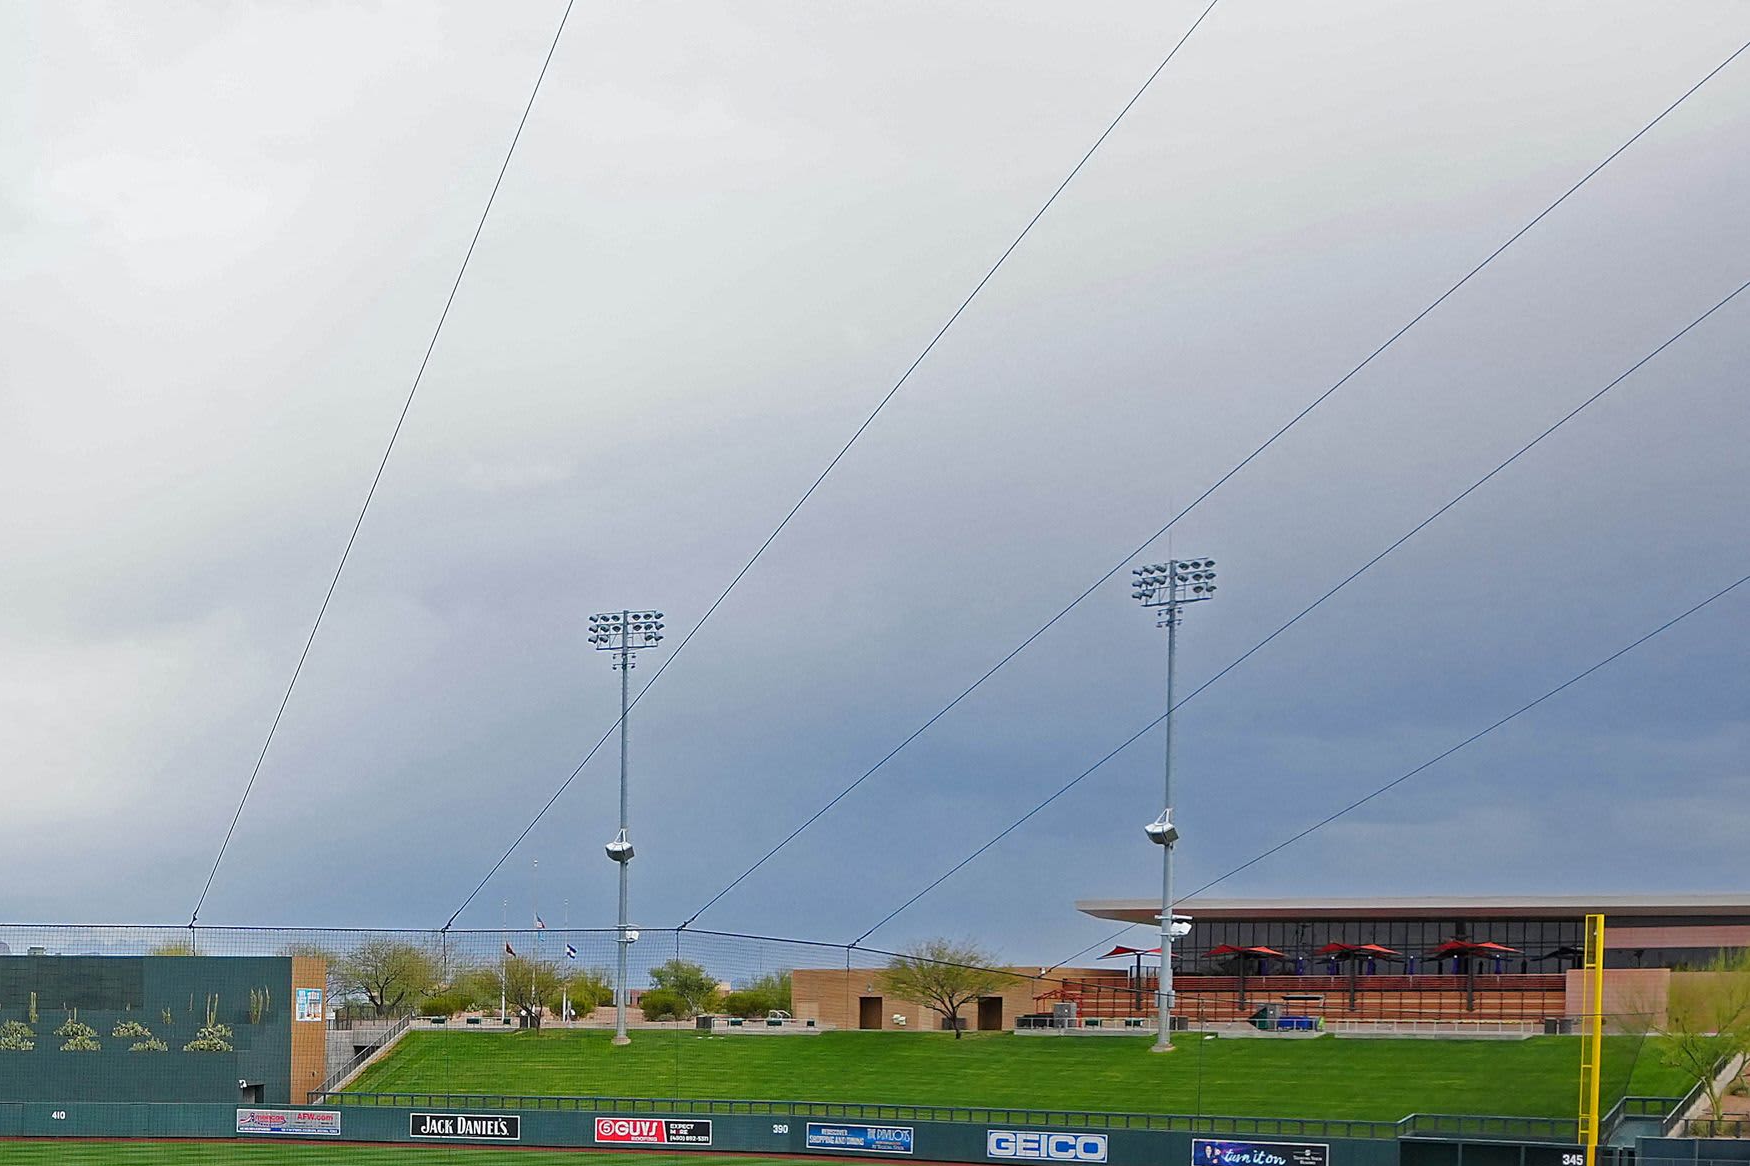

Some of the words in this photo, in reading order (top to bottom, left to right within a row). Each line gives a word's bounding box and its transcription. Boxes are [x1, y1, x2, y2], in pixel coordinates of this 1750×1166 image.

[51, 1111, 66, 1120] 410
[420, 1116, 454, 1134] JACK
[615, 1120, 658, 1136] GUYS
[772, 1124, 789, 1134] 390
[989, 1132, 1106, 1160] GEICO
[1562, 1153, 1584, 1166] 345
